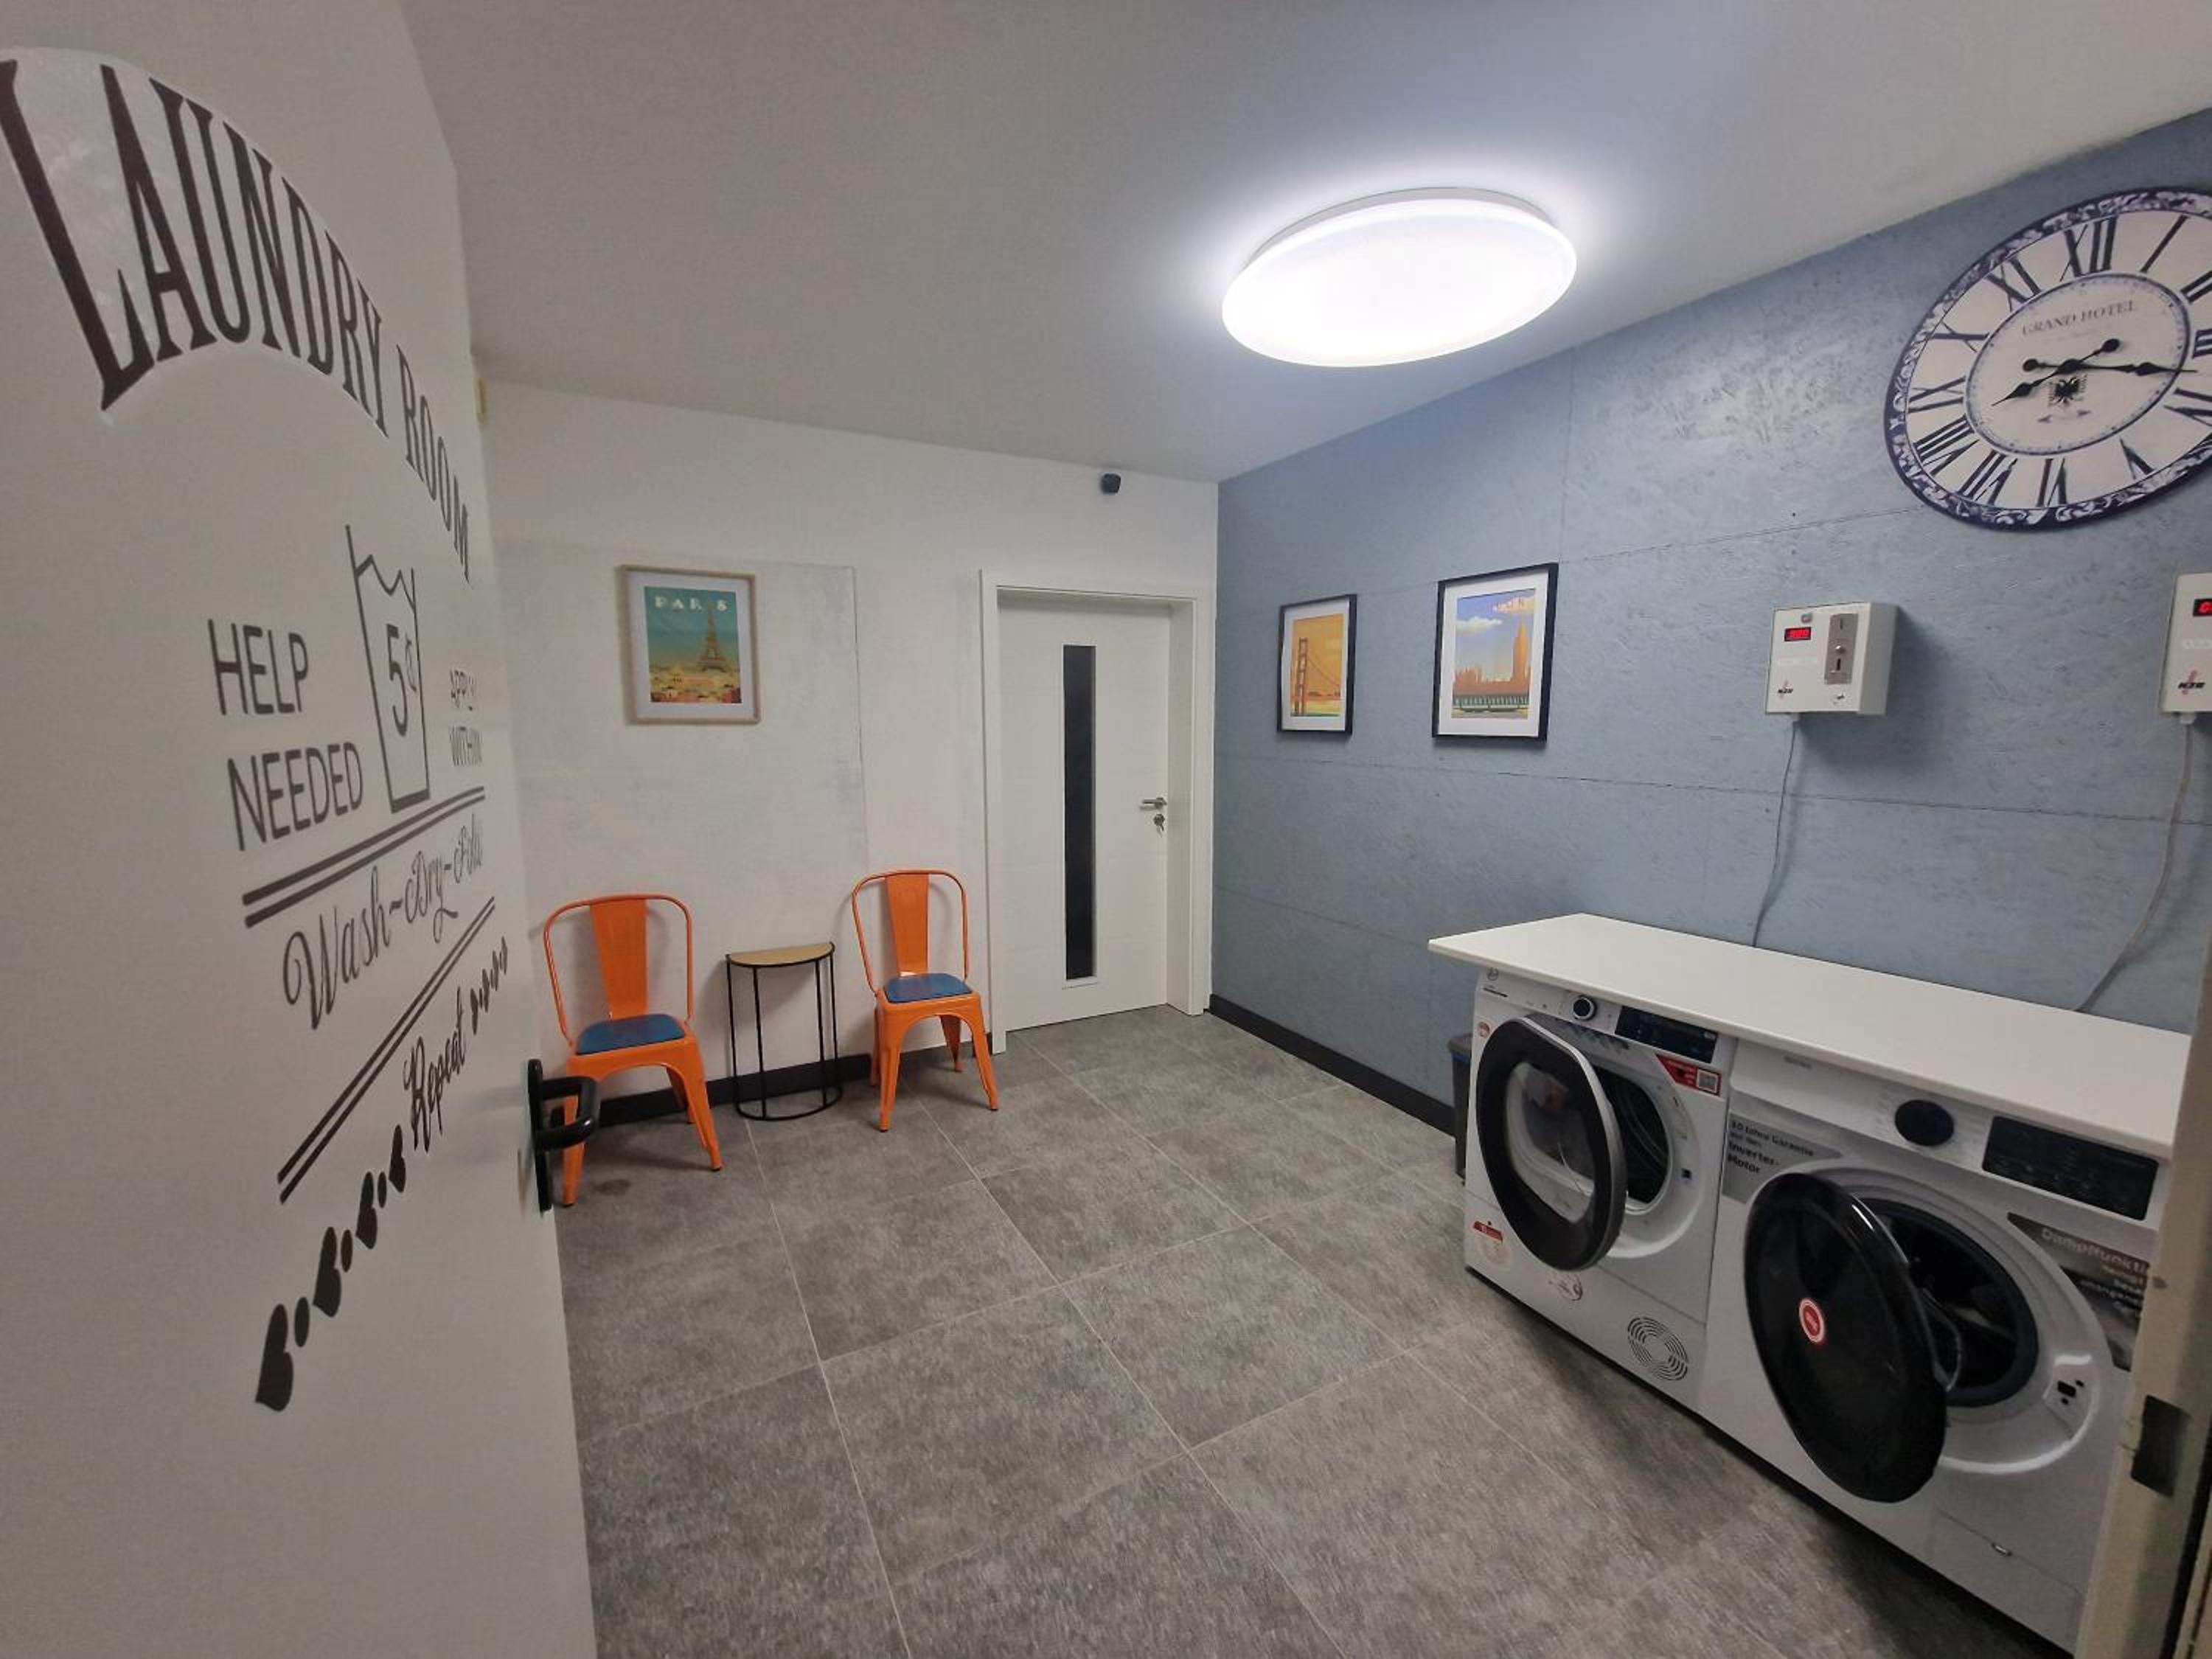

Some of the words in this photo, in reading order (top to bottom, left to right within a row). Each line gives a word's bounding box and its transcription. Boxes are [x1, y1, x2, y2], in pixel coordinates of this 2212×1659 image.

[0, 59, 389, 438] LAUNDRY
[396, 344, 470, 584] ROOM
[2023, 313, 2077, 335] GRAND
[2081, 299, 2135, 322] HOTEL
[208, 618, 309, 716] HELP
[227, 742, 364, 852] NEEDED
[402, 984, 467, 1153] Repeat
[1728, 1153, 1761, 1174] Motor
